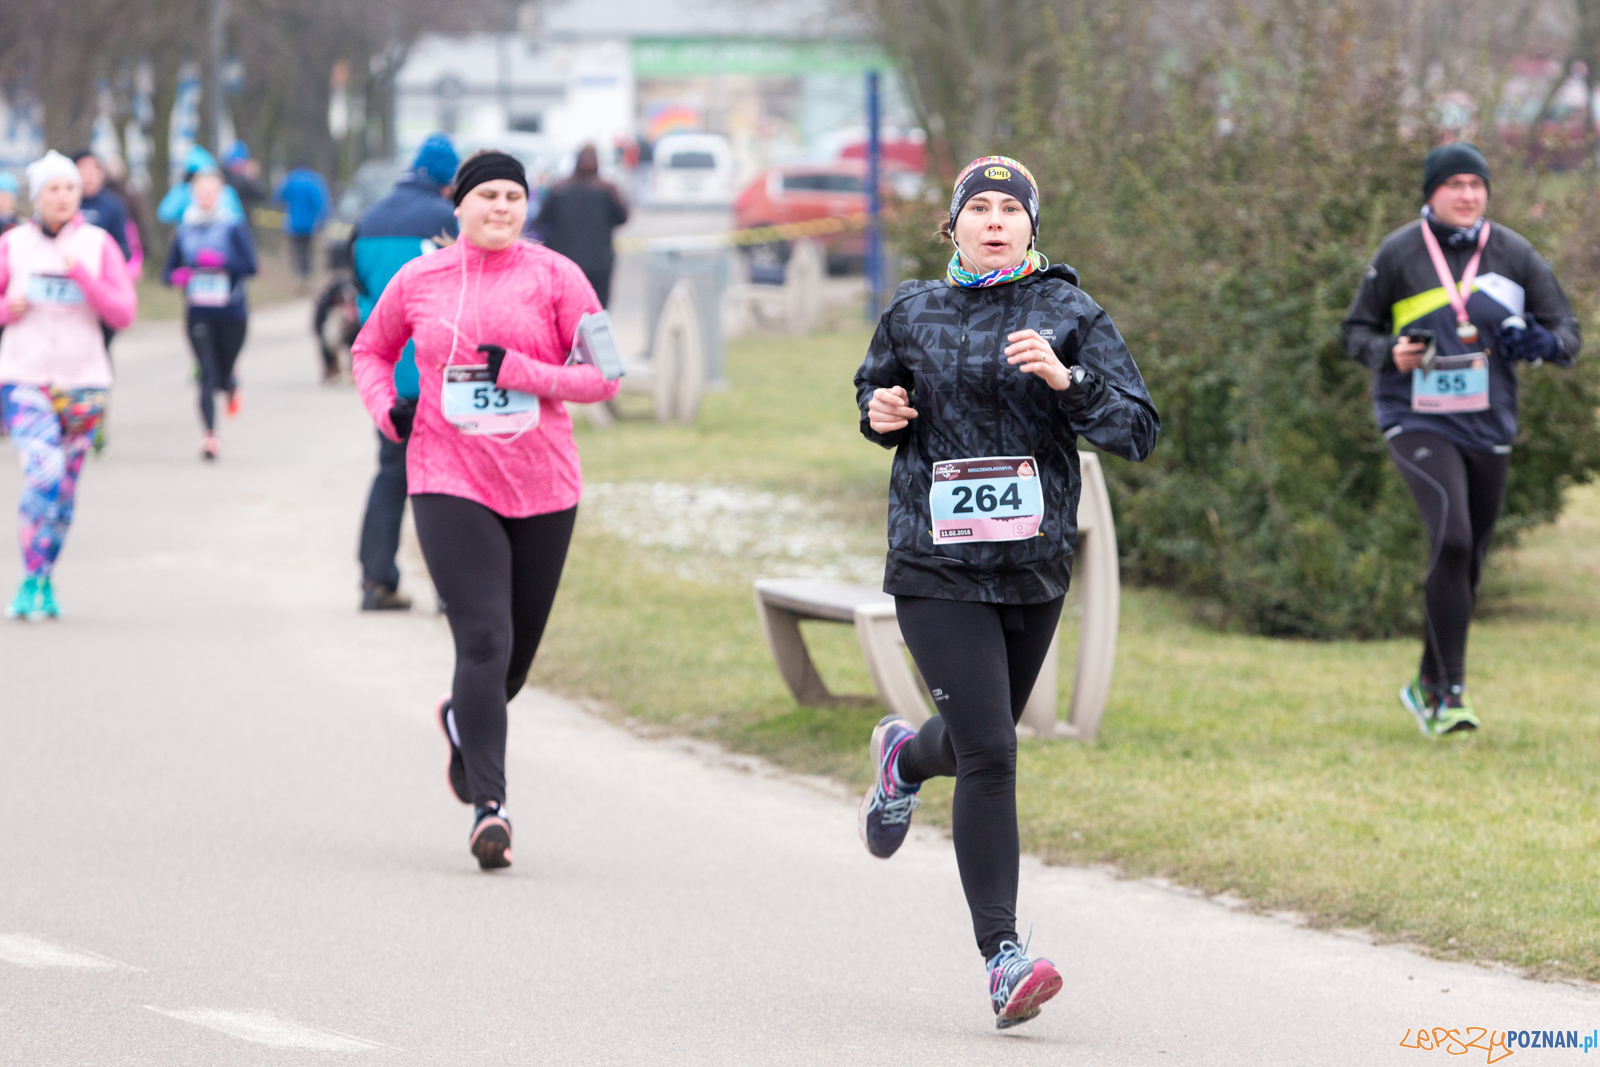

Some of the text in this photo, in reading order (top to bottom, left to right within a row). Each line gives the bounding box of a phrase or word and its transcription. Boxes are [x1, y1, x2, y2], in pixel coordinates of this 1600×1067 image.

[988, 169, 1009, 177] Buff
[1437, 374, 1467, 395] 55
[473, 386, 509, 409] 53
[952, 482, 1022, 514] 264
